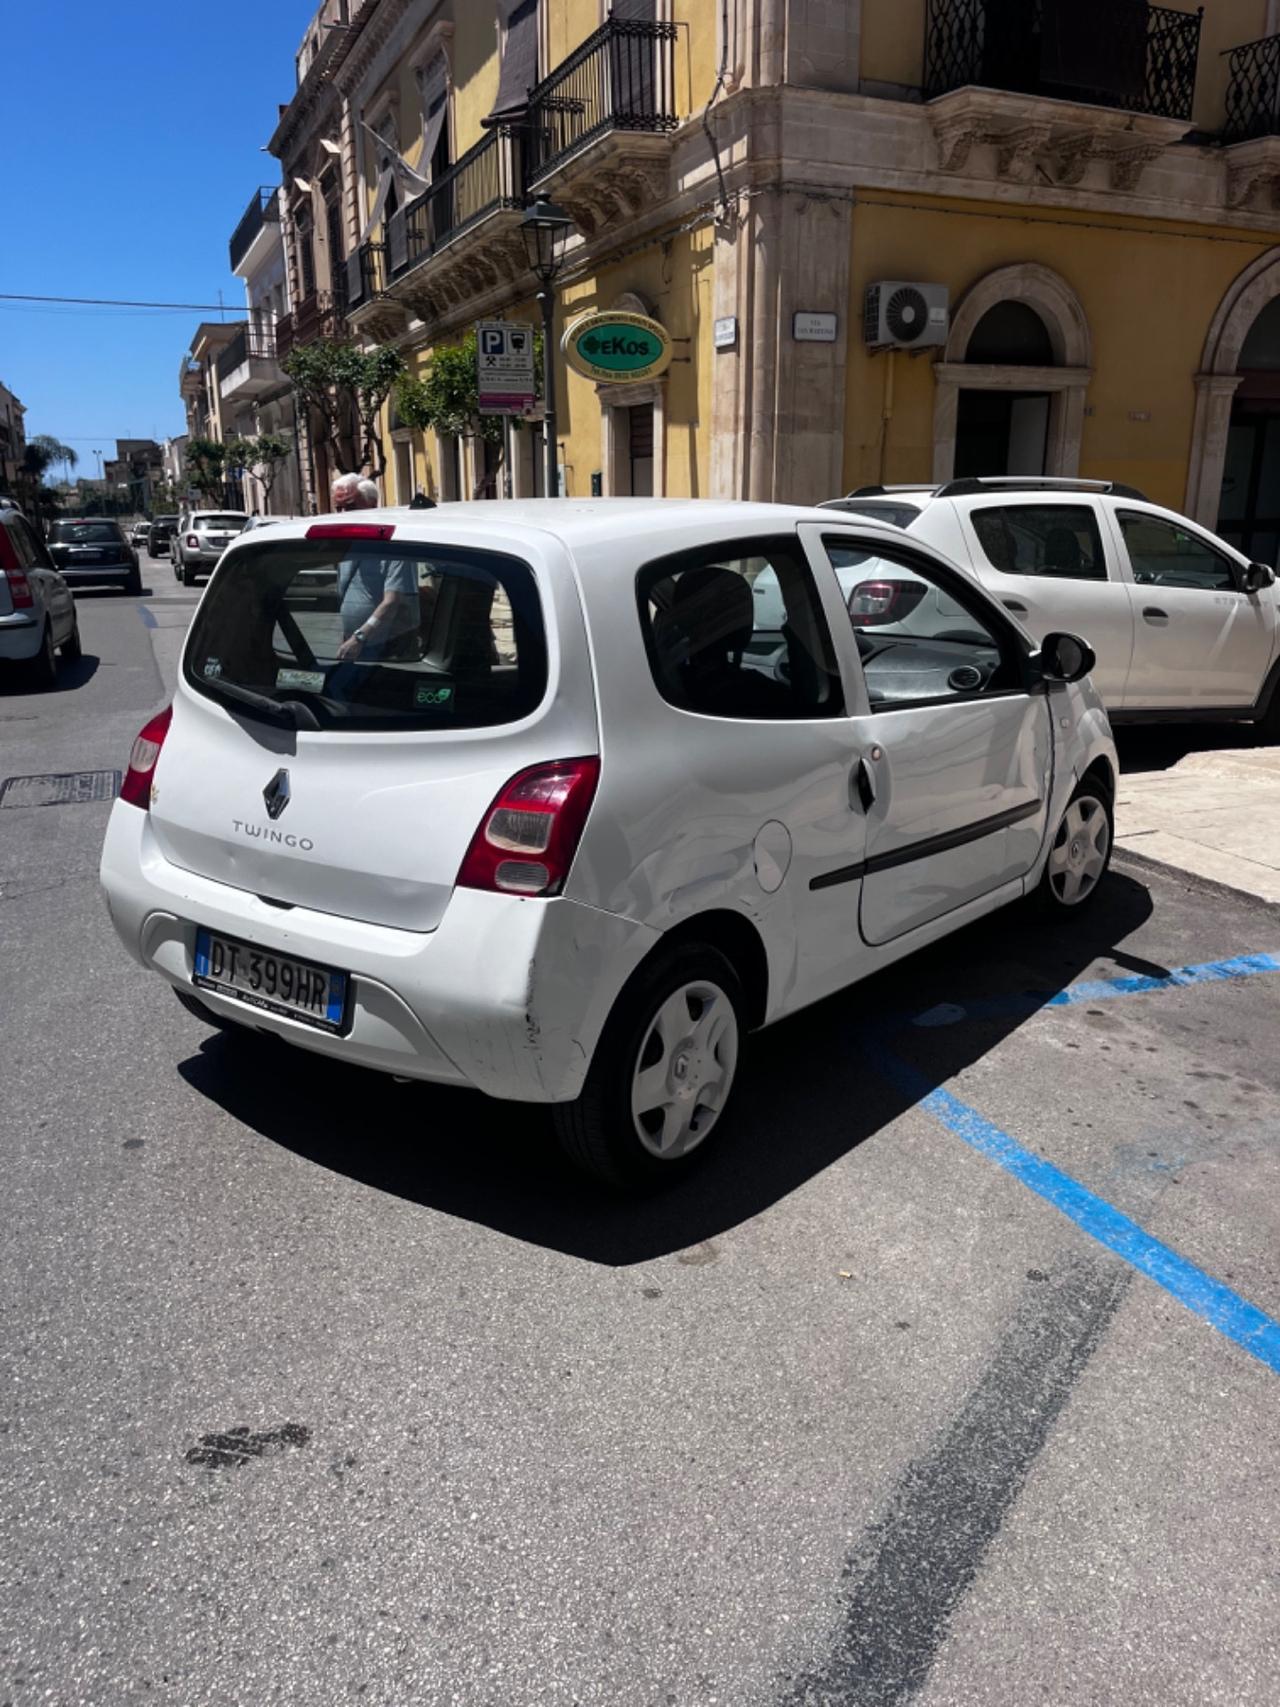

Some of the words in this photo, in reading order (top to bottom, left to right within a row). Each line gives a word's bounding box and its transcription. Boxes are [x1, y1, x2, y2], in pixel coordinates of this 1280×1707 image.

[485, 331, 501, 354] P
[232, 819, 314, 851] TWINGO
[211, 941, 240, 982] DT
[249, 952, 327, 1014] 399HR
